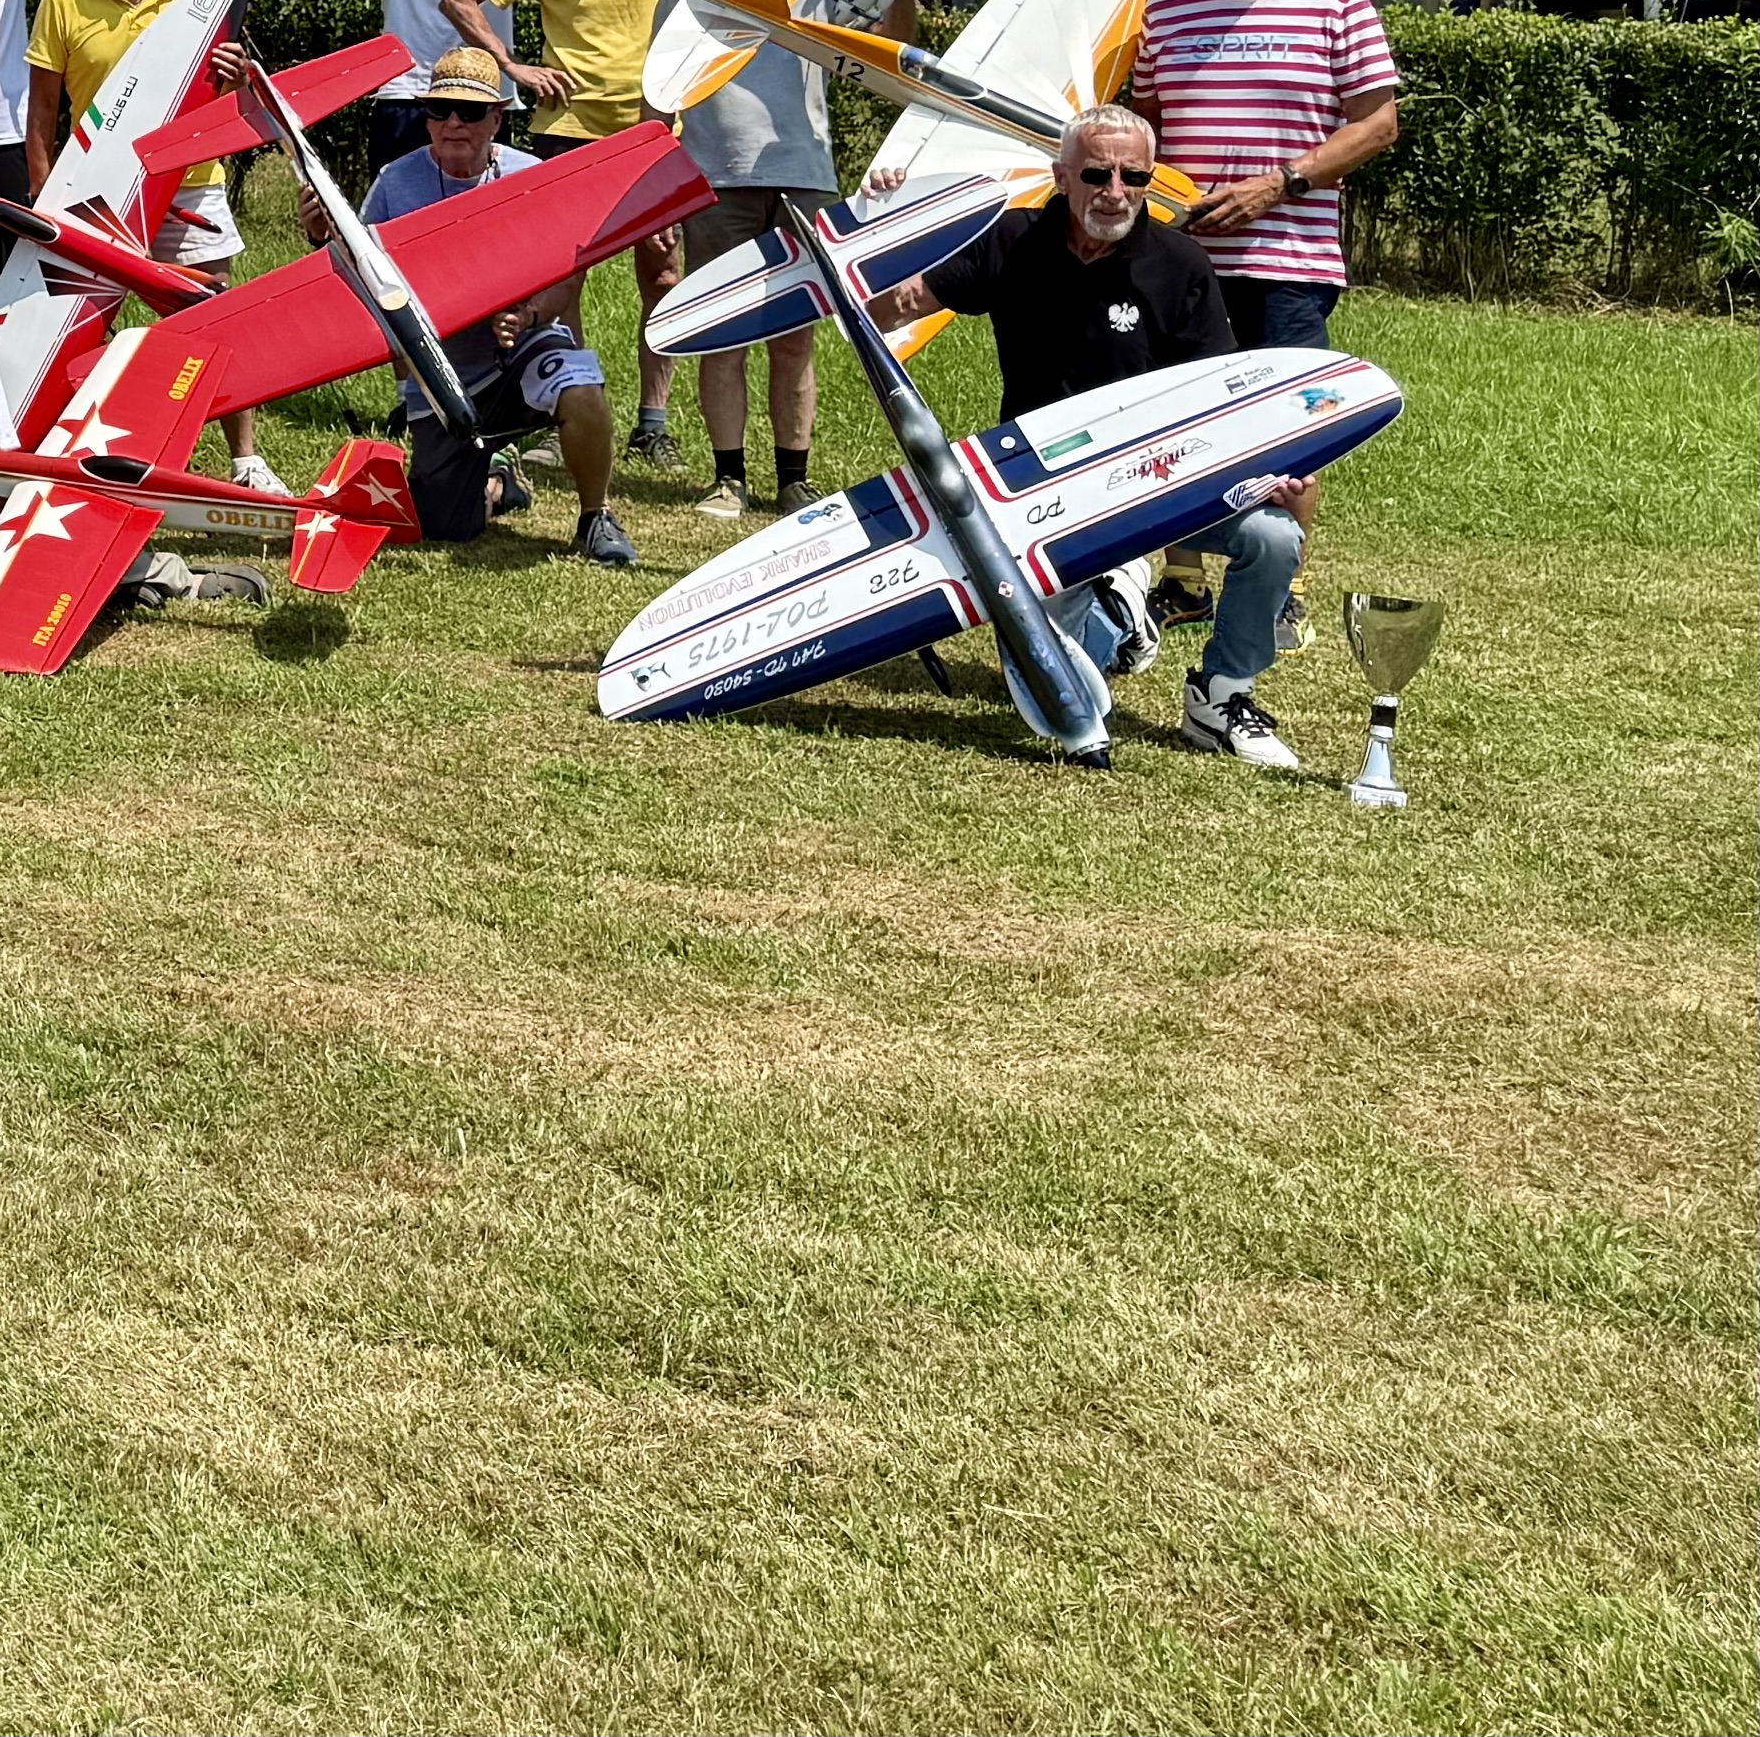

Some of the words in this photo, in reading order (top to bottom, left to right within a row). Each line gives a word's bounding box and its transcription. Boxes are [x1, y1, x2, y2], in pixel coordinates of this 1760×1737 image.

[833, 55, 866, 83] 12
[167, 355, 204, 401] OBELIX
[536, 351, 565, 381] 6
[761, 540, 832, 582] SHARK
[32, 625, 57, 647] ITA
[46, 592, 73, 626] 20010
[638, 575, 754, 632] EVOLUTION
[688, 589, 829, 669] POL-1975
[703, 670, 753, 700] 54030
